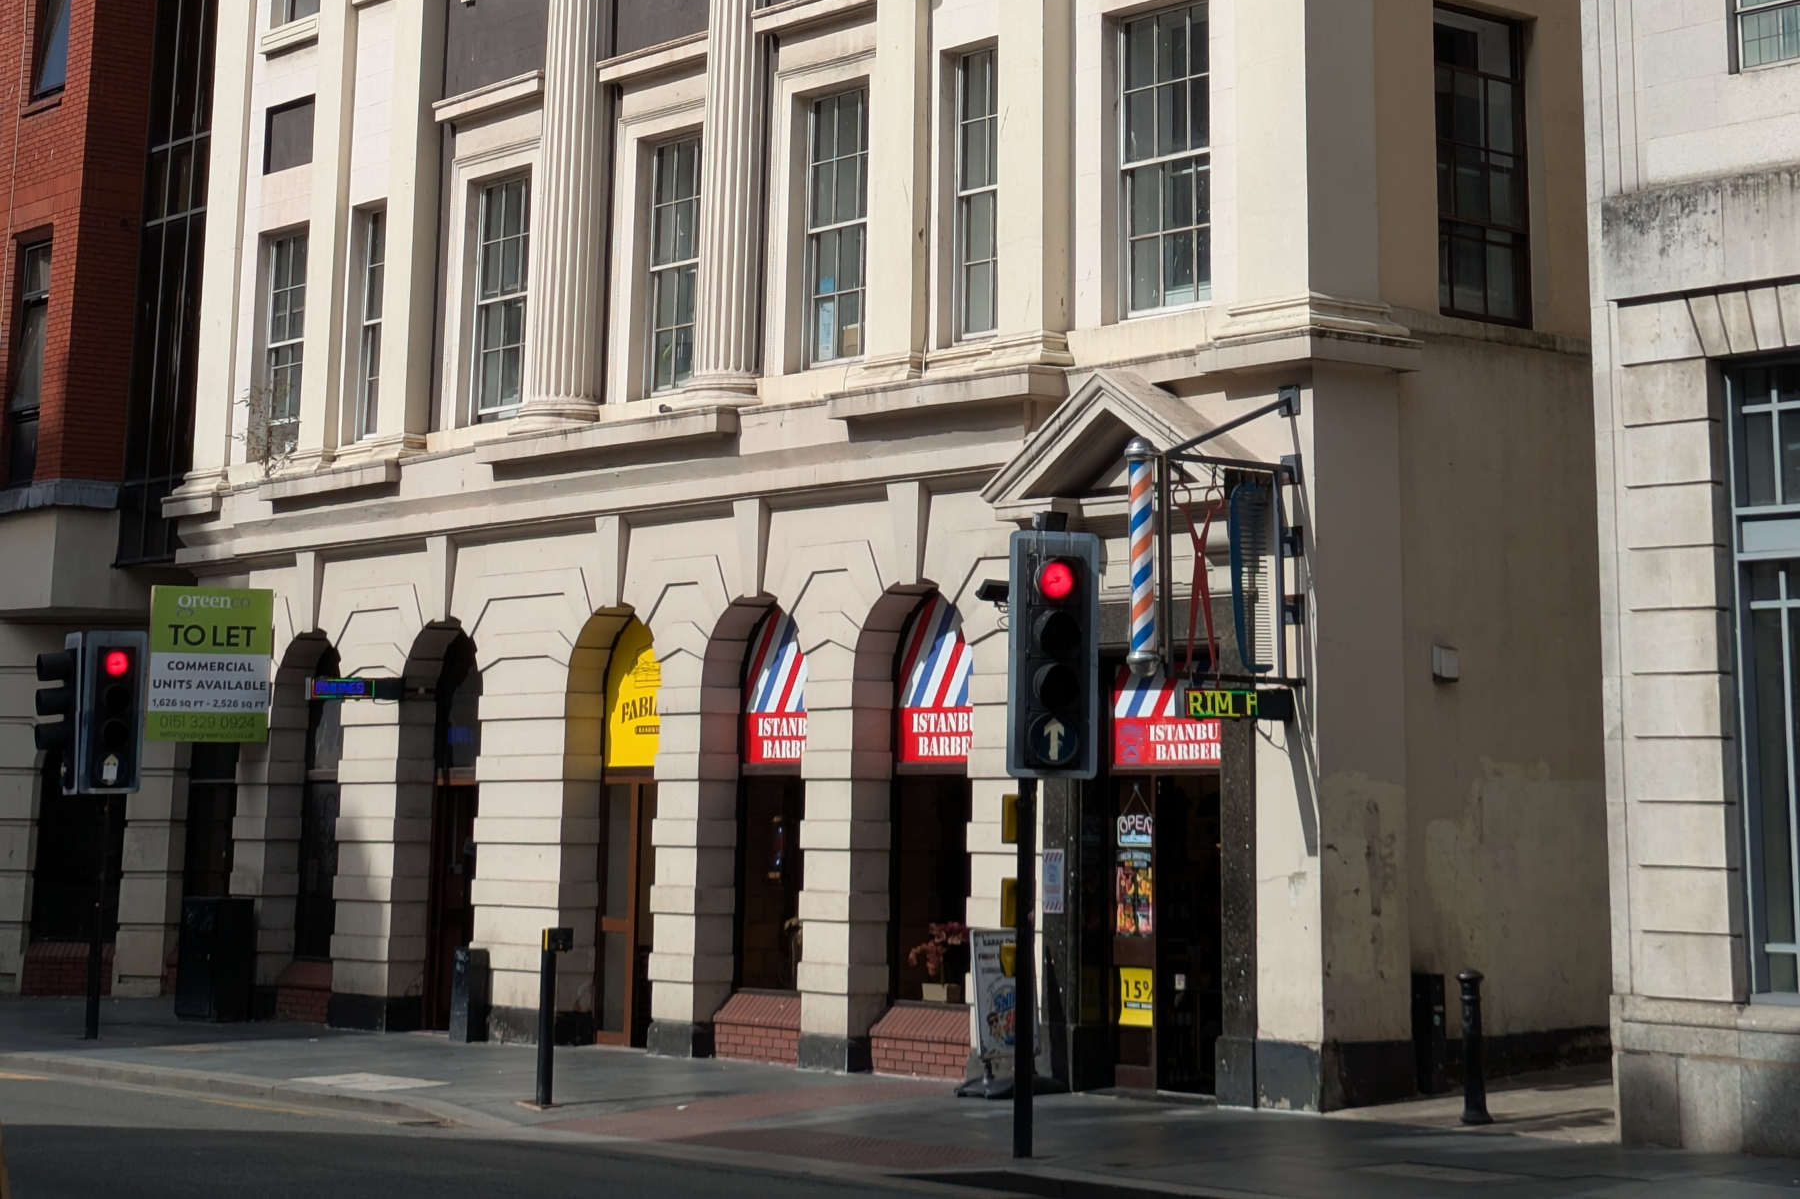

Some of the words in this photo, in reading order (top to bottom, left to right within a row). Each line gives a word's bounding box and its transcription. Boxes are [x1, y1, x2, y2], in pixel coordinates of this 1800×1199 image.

[177, 594, 251, 619] greenco
[168, 624, 206, 646] TO
[212, 625, 257, 648] LET
[167, 660, 255, 672] COMMERCIAL
[153, 679, 193, 690] UNITS
[196, 680, 267, 691] AVAILABLE
[152, 698, 177, 708] 1,626
[180, 700, 191, 708] SQ
[213, 699, 239, 709] 2,526
[241, 701, 253, 709] SQ
[160, 715, 185, 728] 0151
[189, 716, 216, 729] 329
[220, 716, 255, 729] 0924
[160, 731, 254, 740] lettings@greenco.co.uk
[1149, 723, 1221, 742] ISTANBU
[918, 735, 973, 756] BARBE
[1119, 814, 1153, 834] OPEN
